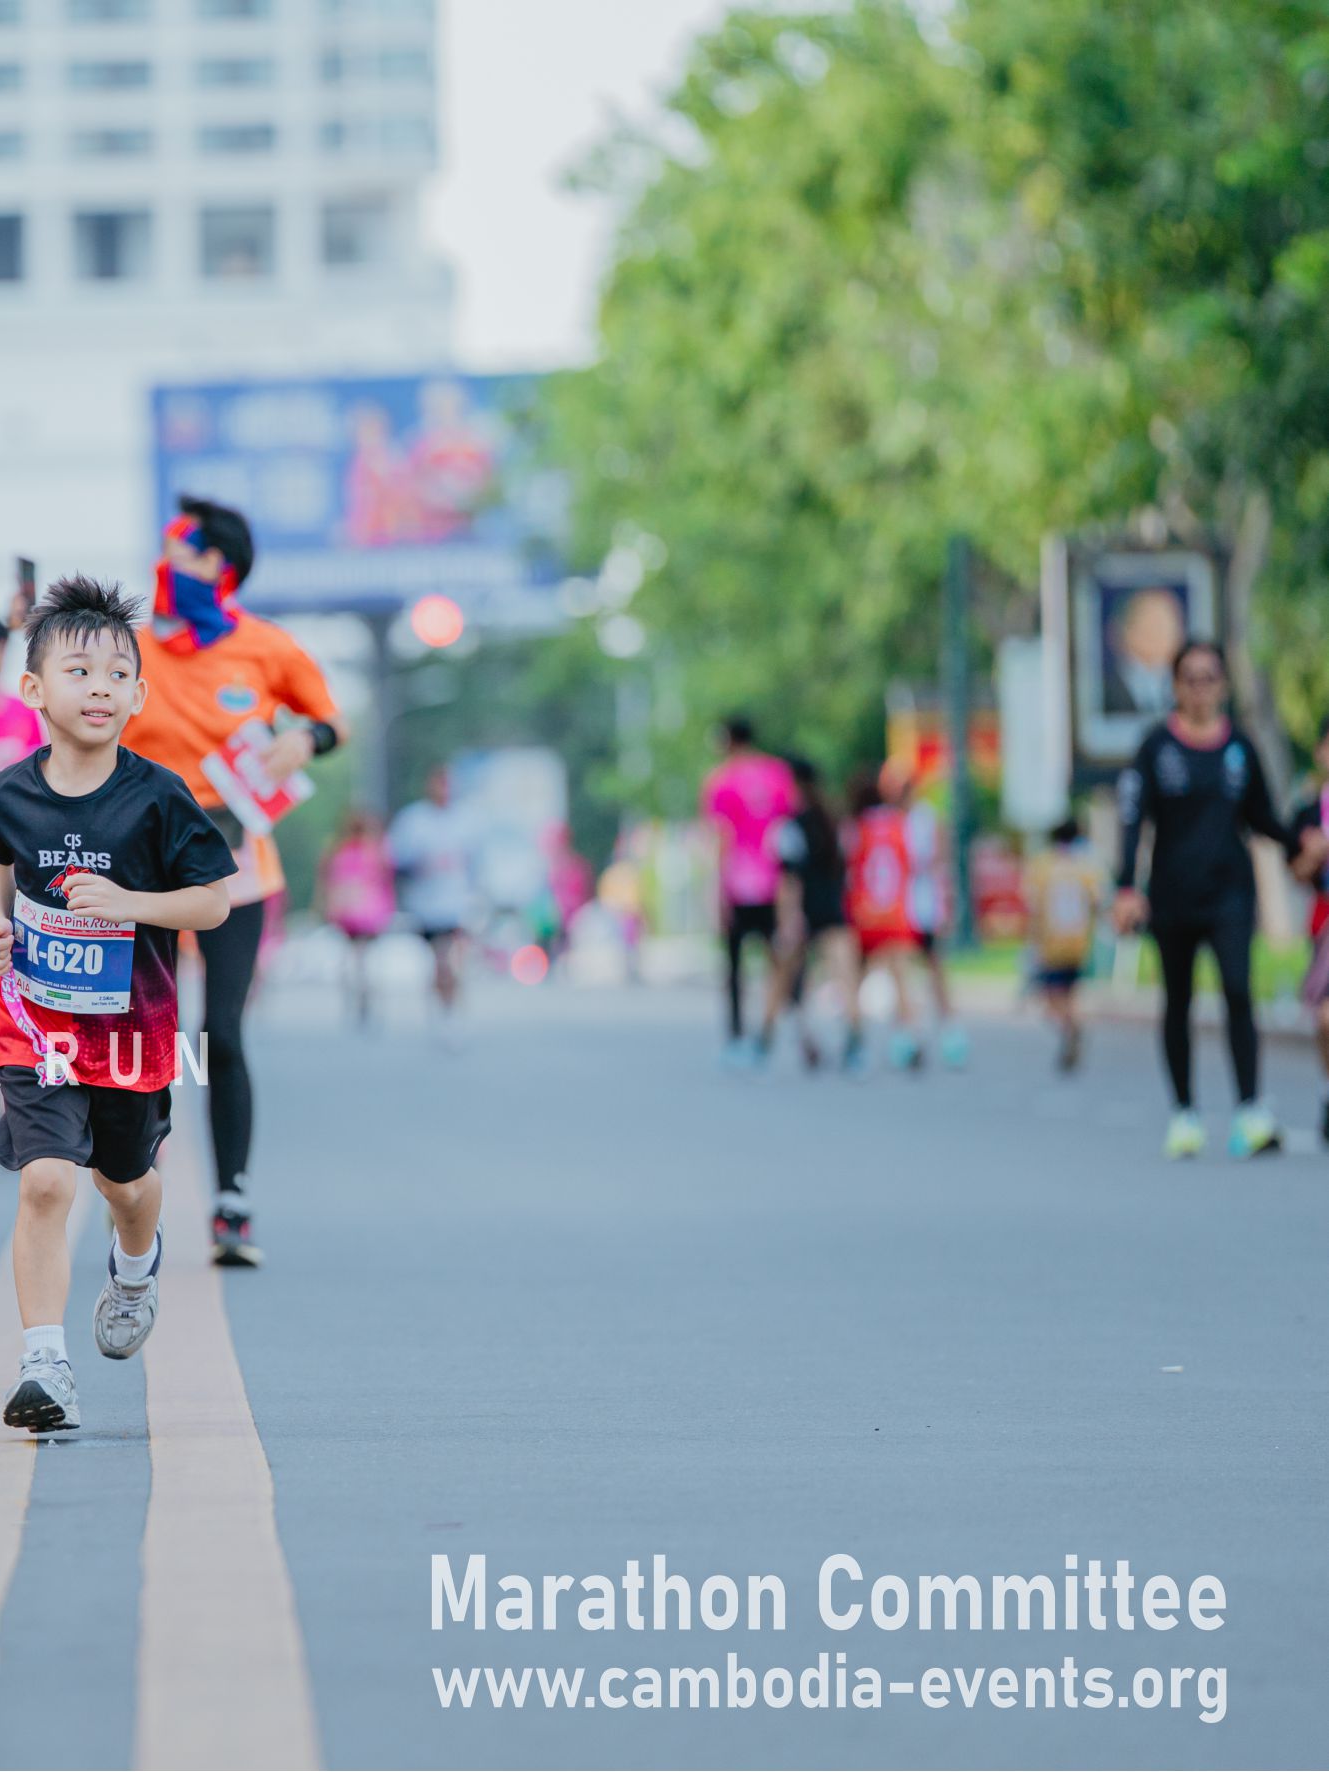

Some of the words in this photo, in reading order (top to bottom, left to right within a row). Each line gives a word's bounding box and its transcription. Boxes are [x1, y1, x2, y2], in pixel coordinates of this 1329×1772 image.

[38, 849, 111, 870] BEARS
[27, 931, 103, 975] K-620
[16, 977, 30, 995] AIA
